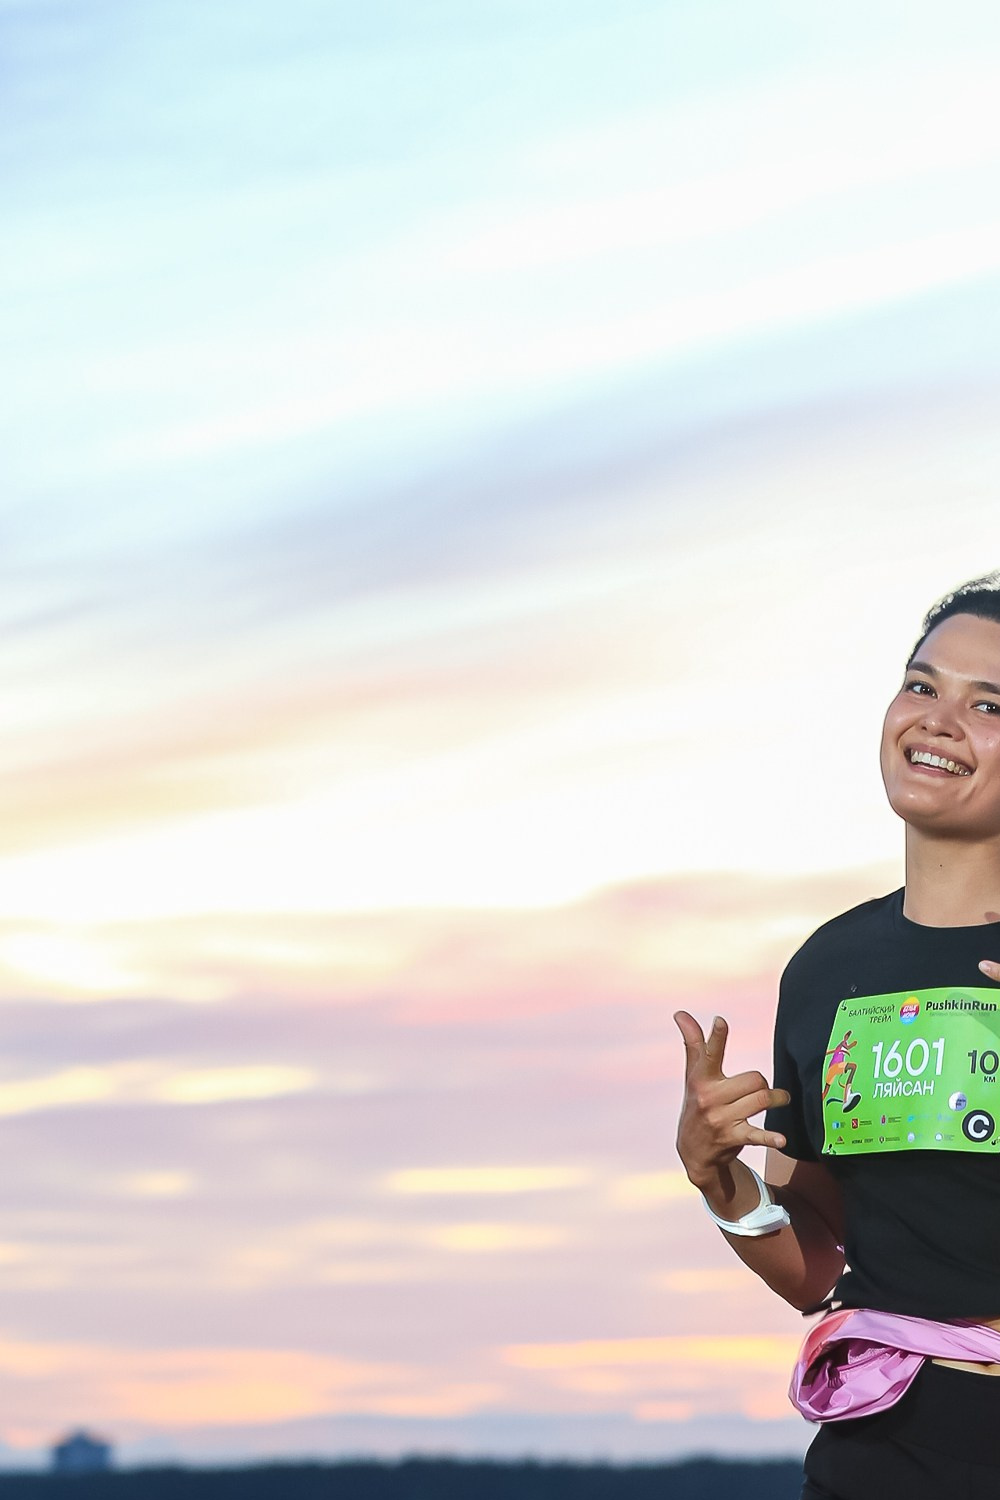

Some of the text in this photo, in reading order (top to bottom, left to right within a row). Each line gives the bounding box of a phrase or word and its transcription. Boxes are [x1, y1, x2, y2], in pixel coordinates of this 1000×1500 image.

[848, 1004, 896, 1018] БАЛТИЙСКИЙ
[926, 999, 998, 1012] PushkinRun
[869, 1014, 893, 1024] ТРЕЙЛ
[872, 1037, 945, 1079] 1601
[967, 1049, 1000, 1075] 10
[872, 1079, 935, 1099] ЛЯЙСАН
